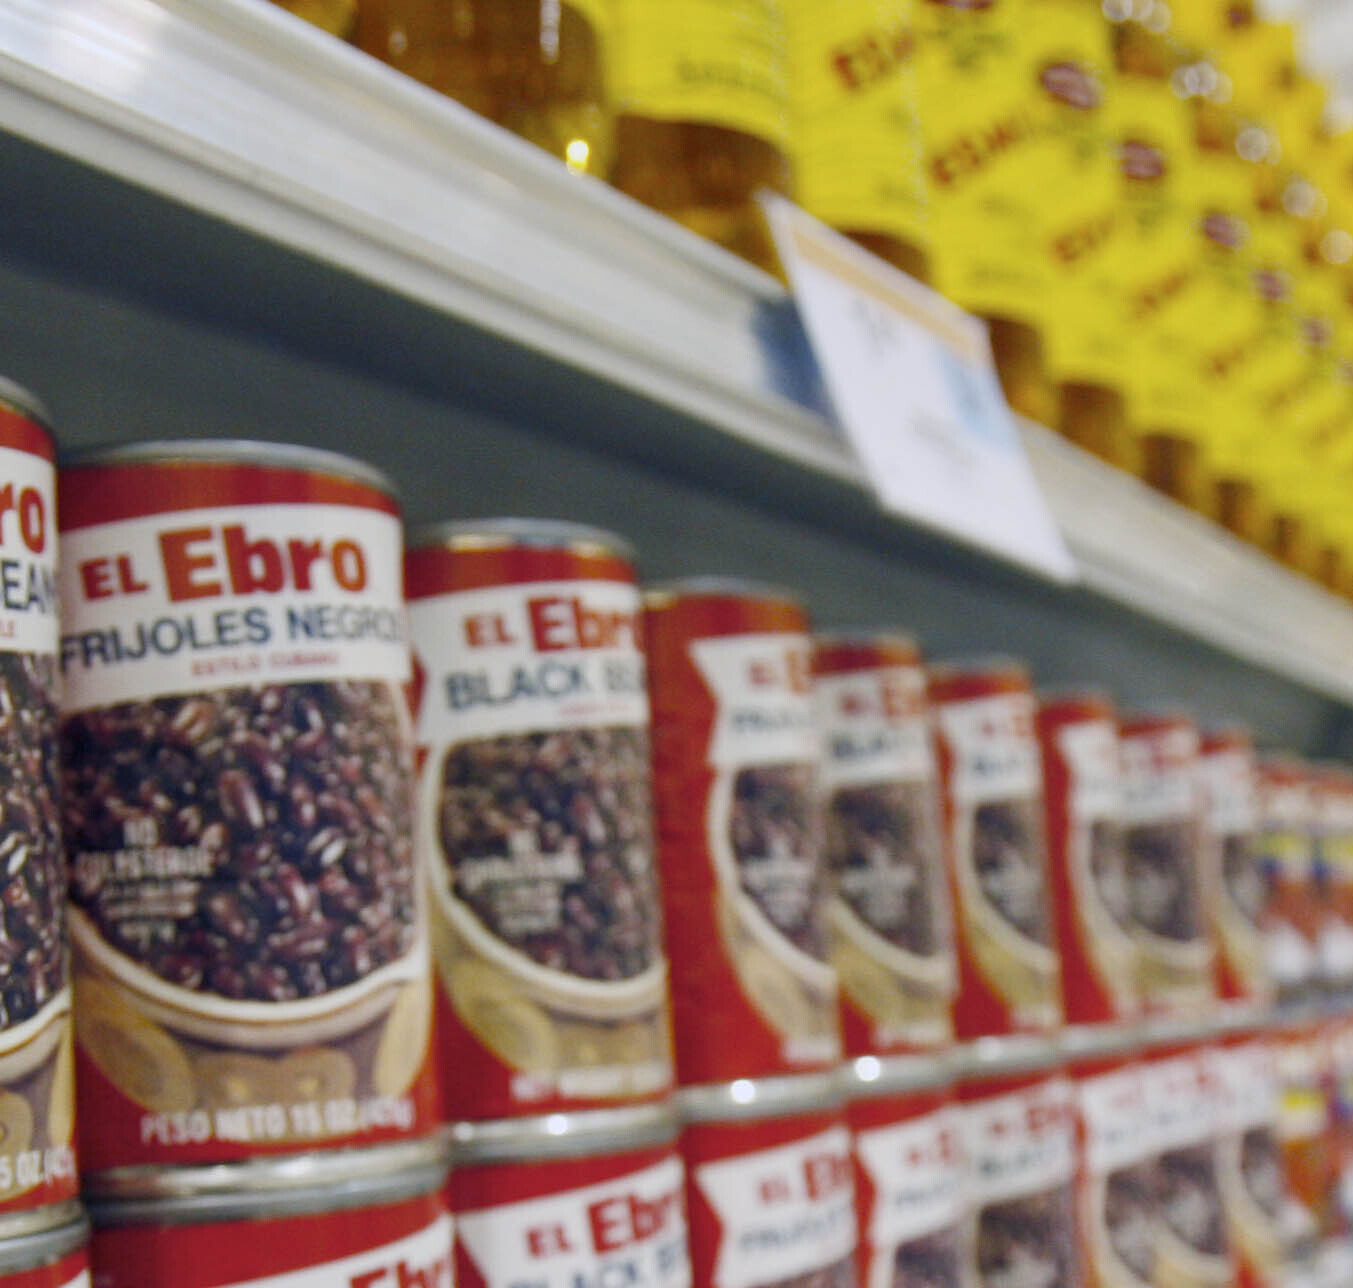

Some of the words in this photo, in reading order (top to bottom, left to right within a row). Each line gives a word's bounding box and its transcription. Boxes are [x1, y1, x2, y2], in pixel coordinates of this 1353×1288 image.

[78, 553, 149, 600] EL
[158, 523, 367, 602] Ebro
[58, 606, 272, 673] FRIJOLES
[462, 612, 516, 649] EL
